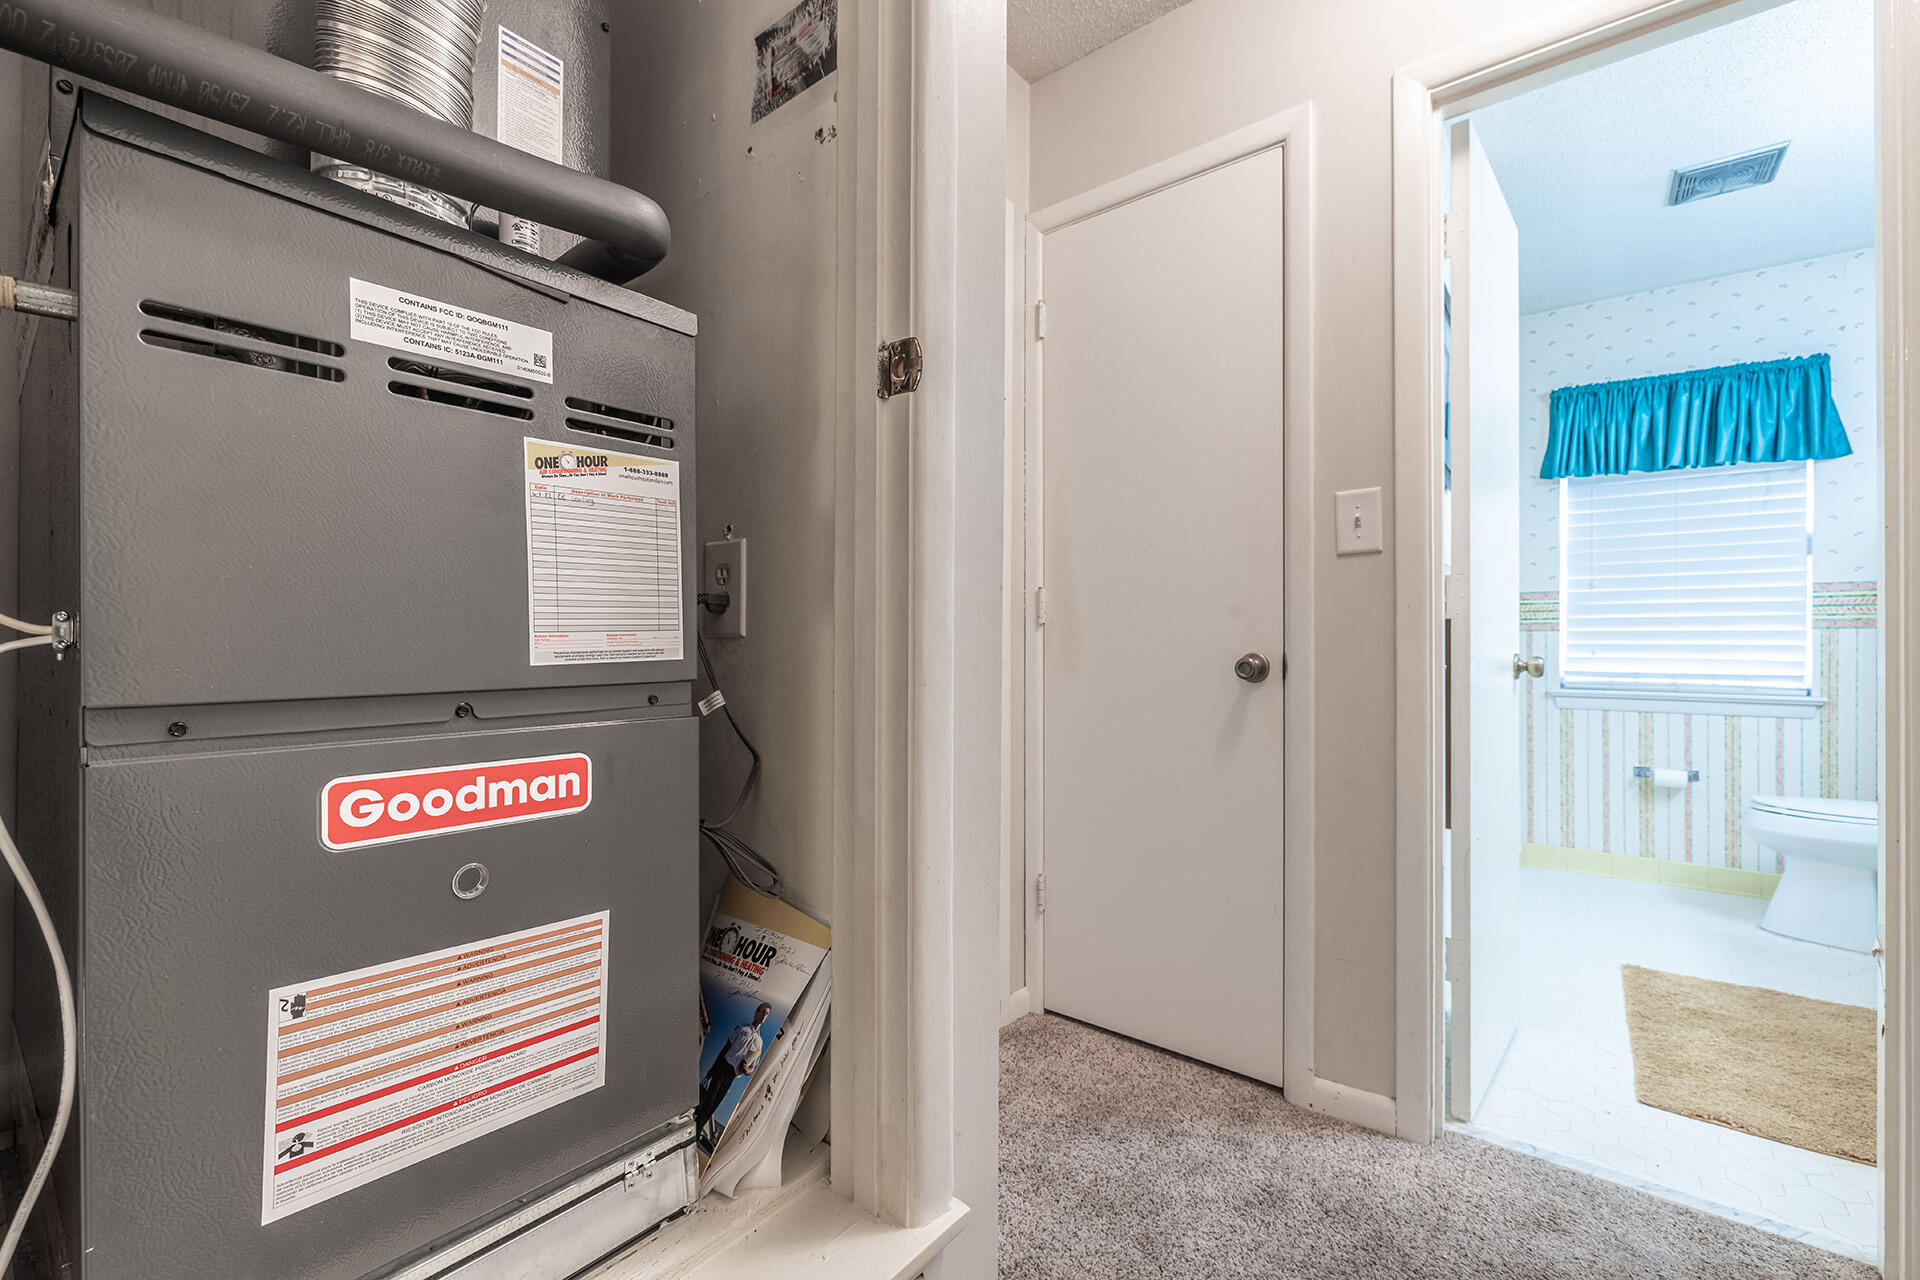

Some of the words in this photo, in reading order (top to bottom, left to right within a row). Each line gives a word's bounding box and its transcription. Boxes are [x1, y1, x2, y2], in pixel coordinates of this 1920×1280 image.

[398, 295, 437, 312] CONTAINS
[439, 306, 453, 317] FCC
[455, 311, 465, 320] ID:
[466, 314, 508, 332] QOQBGM111
[403, 335, 441, 351] CONTAINS
[443, 345, 453, 354] IC:
[454, 348, 503, 365] 5123A-BGM111
[535, 456, 559, 470] ONE
[576, 455, 609, 468] HOUR
[339, 772, 581, 828] Goodman
[463, 945, 494, 959] WARNING
[732, 936, 777, 968] HOUR
[462, 953, 506, 970] ADVERTENCIA
[740, 960, 766, 976] HEATING
[462, 971, 493, 986] WARNING
[461, 986, 506, 1005] ADVERTENCIA
[461, 1012, 492, 1028] WARNING
[460, 1027, 505, 1048] ADVERTENCIA
[417, 1078, 442, 1092] CARBON
[443, 1067, 474, 1083] MONOXIDE
[474, 1056, 504, 1072] POISONING
[505, 1049, 527, 1061] HAZARD
[459, 1054, 487, 1070] DANGER
[400, 1120, 425, 1135] RIESGO
[425, 1117, 434, 1126] DE
[476, 1096, 488, 1107] POR
[518, 1082, 525, 1091] DE
[526, 1072, 552, 1087] CARBONO
[458, 1087, 488, 1105] PELIGRO
